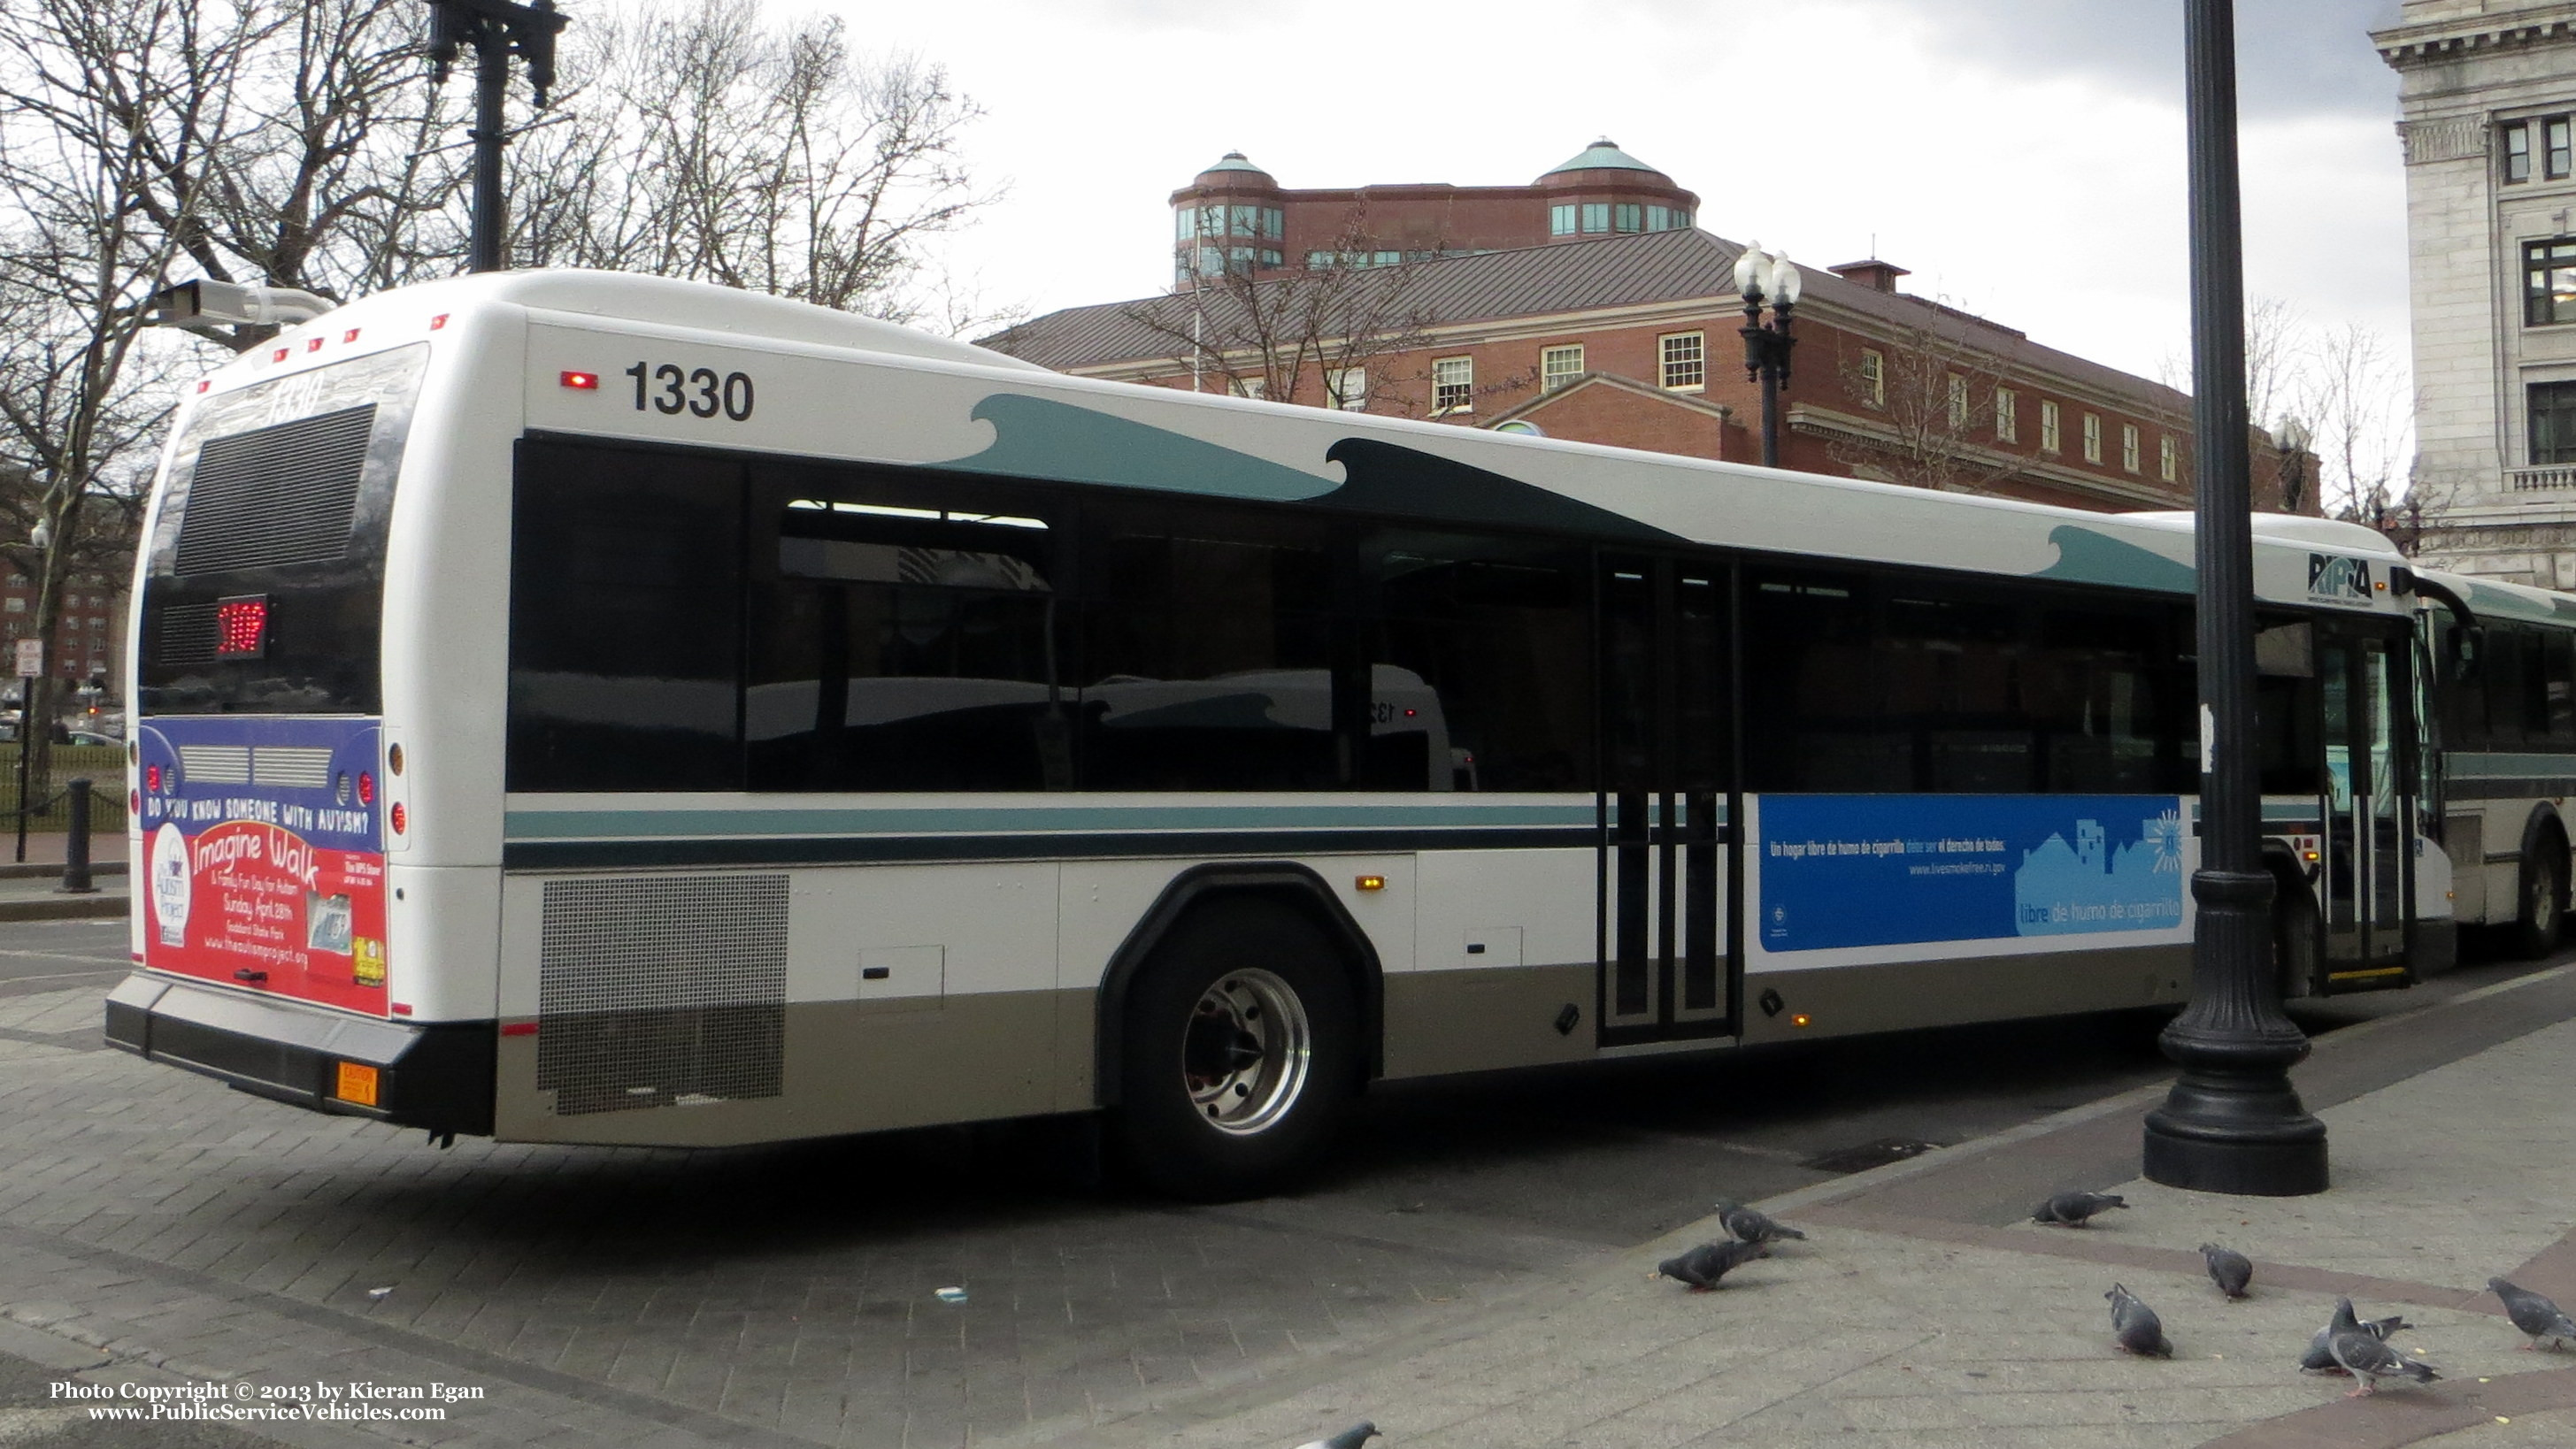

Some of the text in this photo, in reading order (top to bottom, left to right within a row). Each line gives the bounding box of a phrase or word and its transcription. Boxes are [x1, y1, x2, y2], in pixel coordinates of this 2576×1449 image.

[267, 371, 325, 426] 1330
[627, 361, 754, 422] 1330
[148, 797, 370, 834] DO YOU KNOW SOMEONE WITH AUTISM?
[194, 826, 319, 891] Imagine Walk
[1770, 840, 1782, 856] Un
[1783, 840, 1806, 861] hogar
[1807, 840, 1826, 856] libre
[1826, 840, 1837, 855] de
[1838, 840, 1859, 855] humo
[1861, 839, 1871, 855] de
[1872, 839, 1904, 858] cigarrillo
[1925, 841, 1937, 854] ser
[1937, 838, 1946, 853] el
[1947, 838, 1974, 852] derecho
[1975, 837, 1985, 852] de
[1909, 862, 2006, 876] www.livesmokefree.ri.gov
[2020, 896, 2180, 924] libre de humo de cigarrillo
[204, 935, 309, 971] www.theautismproject.org
